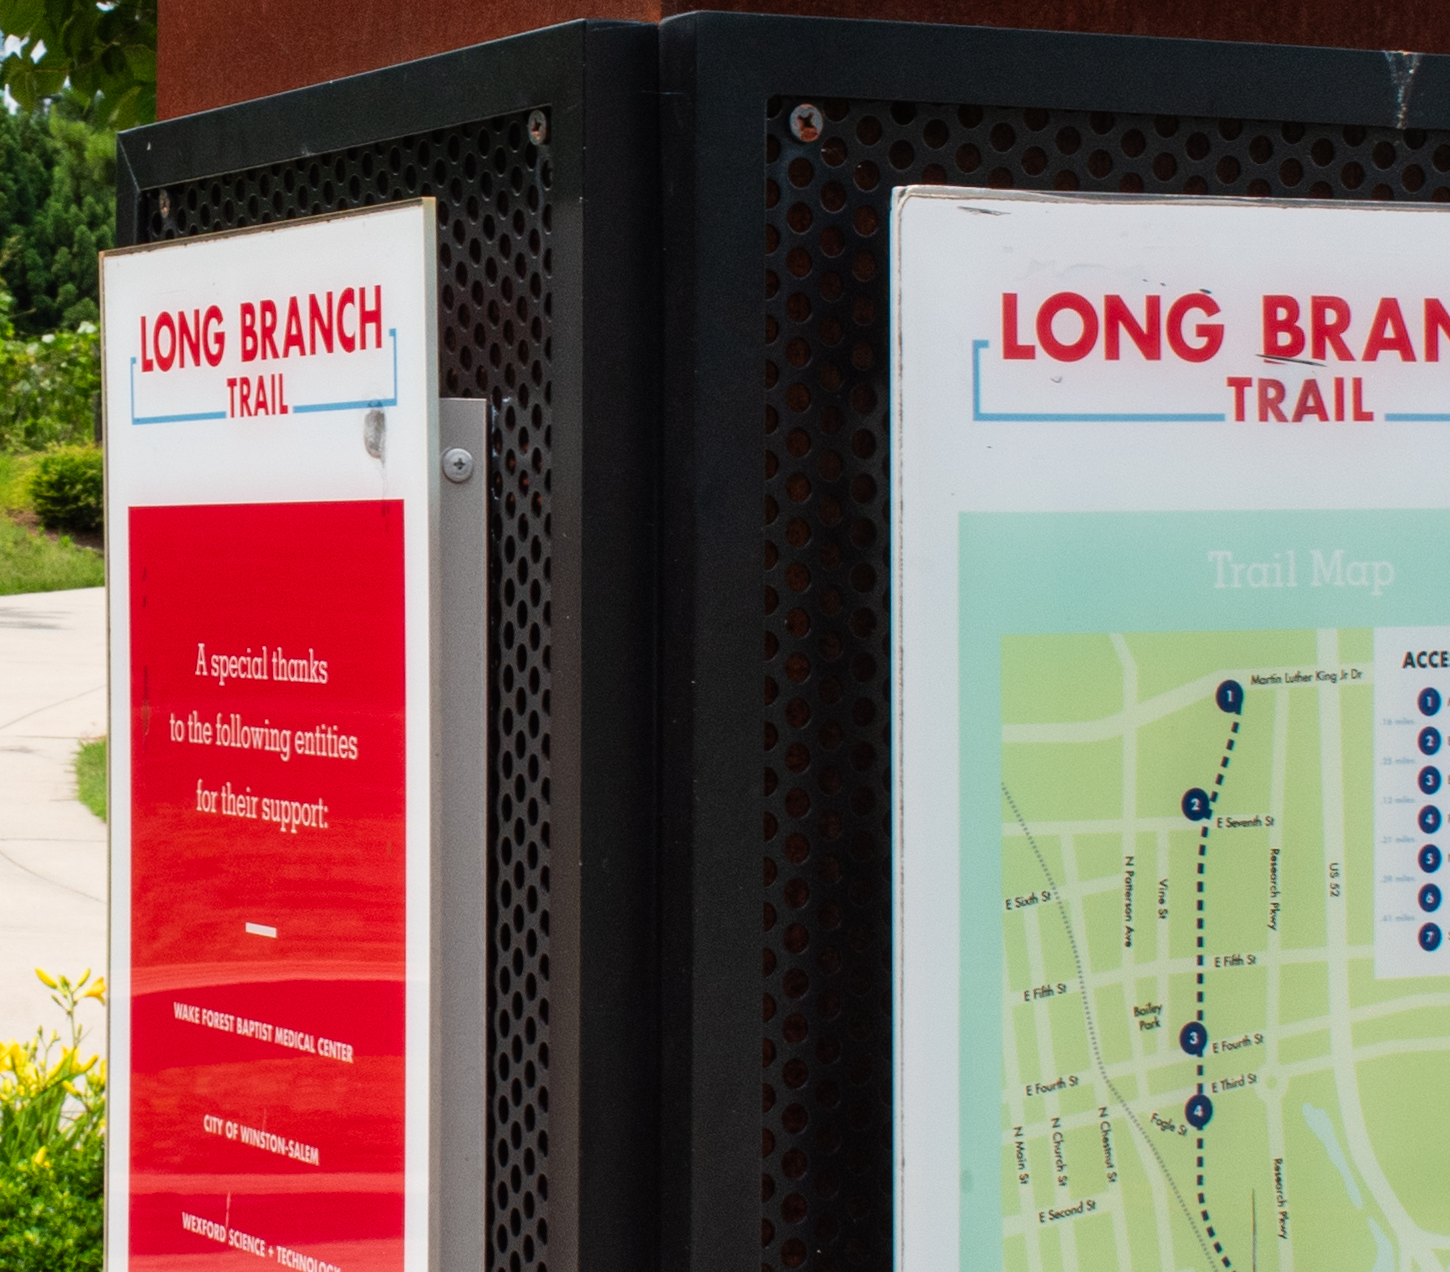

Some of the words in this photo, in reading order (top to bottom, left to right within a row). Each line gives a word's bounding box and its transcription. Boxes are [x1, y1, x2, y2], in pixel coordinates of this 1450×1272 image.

[140, 304, 225, 372] LONG
[240, 284, 383, 362] BRANCH
[1001, 291, 1225, 363] LONG
[227, 373, 288, 418] TRAIL
[1226, 376, 1375, 424] TRAIL
[1208, 549, 1299, 591] Trail
[1308, 550, 1395, 596] Map
[195, 643, 208, 678] A
[211, 644, 268, 687] special
[271, 647, 328, 686] thanks
[1251, 674, 1282, 686] Martin
[1284, 672, 1312, 684] Luther
[1315, 671, 1337, 684] King
[1339, 670, 1349, 681] Jr
[1351, 669, 1363, 680] Dr
[169, 712, 184, 743] to
[187, 711, 213, 747] the
[215, 715, 291, 762] following
[294, 724, 358, 761] entities
[1425, 735, 1434, 747] 2
[1425, 774, 1434, 786] 3
[196, 779, 218, 814] for
[220, 782, 259, 820] their
[262, 793, 329, 833] support:
[1191, 798, 1200, 810] 2
[1217, 817, 1223, 828] E
[1225, 816, 1262, 828] Seventh
[1264, 815, 1275, 827] St
[1425, 813, 1435, 826] 4
[1425, 852, 1434, 865] 5
[1425, 891, 1434, 904] 6
[1426, 931, 1434, 943] 7
[1214, 956, 1221, 968] E
[1223, 954, 1244, 967] Fifth
[1246, 954, 1257, 965] St
[1133, 1003, 1163, 1018] Bailey
[1139, 1016, 1161, 1031] Park
[174, 1001, 200, 1024] WAKE
[201, 1009, 234, 1033] FOREST
[236, 1016, 273, 1042] BAPTIST
[275, 1026, 315, 1054] MEDICAL
[318, 1037, 354, 1064] CENTER
[1189, 1032, 1198, 1044] 3
[1212, 1042, 1219, 1054] E
[1221, 1037, 1252, 1053] Fourth
[1254, 1034, 1264, 1045] St
[1212, 1082, 1218, 1094] E
[1221, 1076, 1245, 1092] Third
[1247, 1073, 1257, 1085] St
[1194, 1105, 1204, 1117] 4
[203, 1114, 223, 1134] CITY
[225, 1121, 238, 1139] OF
[240, 1125, 319, 1166] WINSTON-SALEM
[182, 1211, 226, 1244] WEXFORD
[228, 1228, 265, 1258] SCIENCE
[267, 1245, 274, 1257] +
